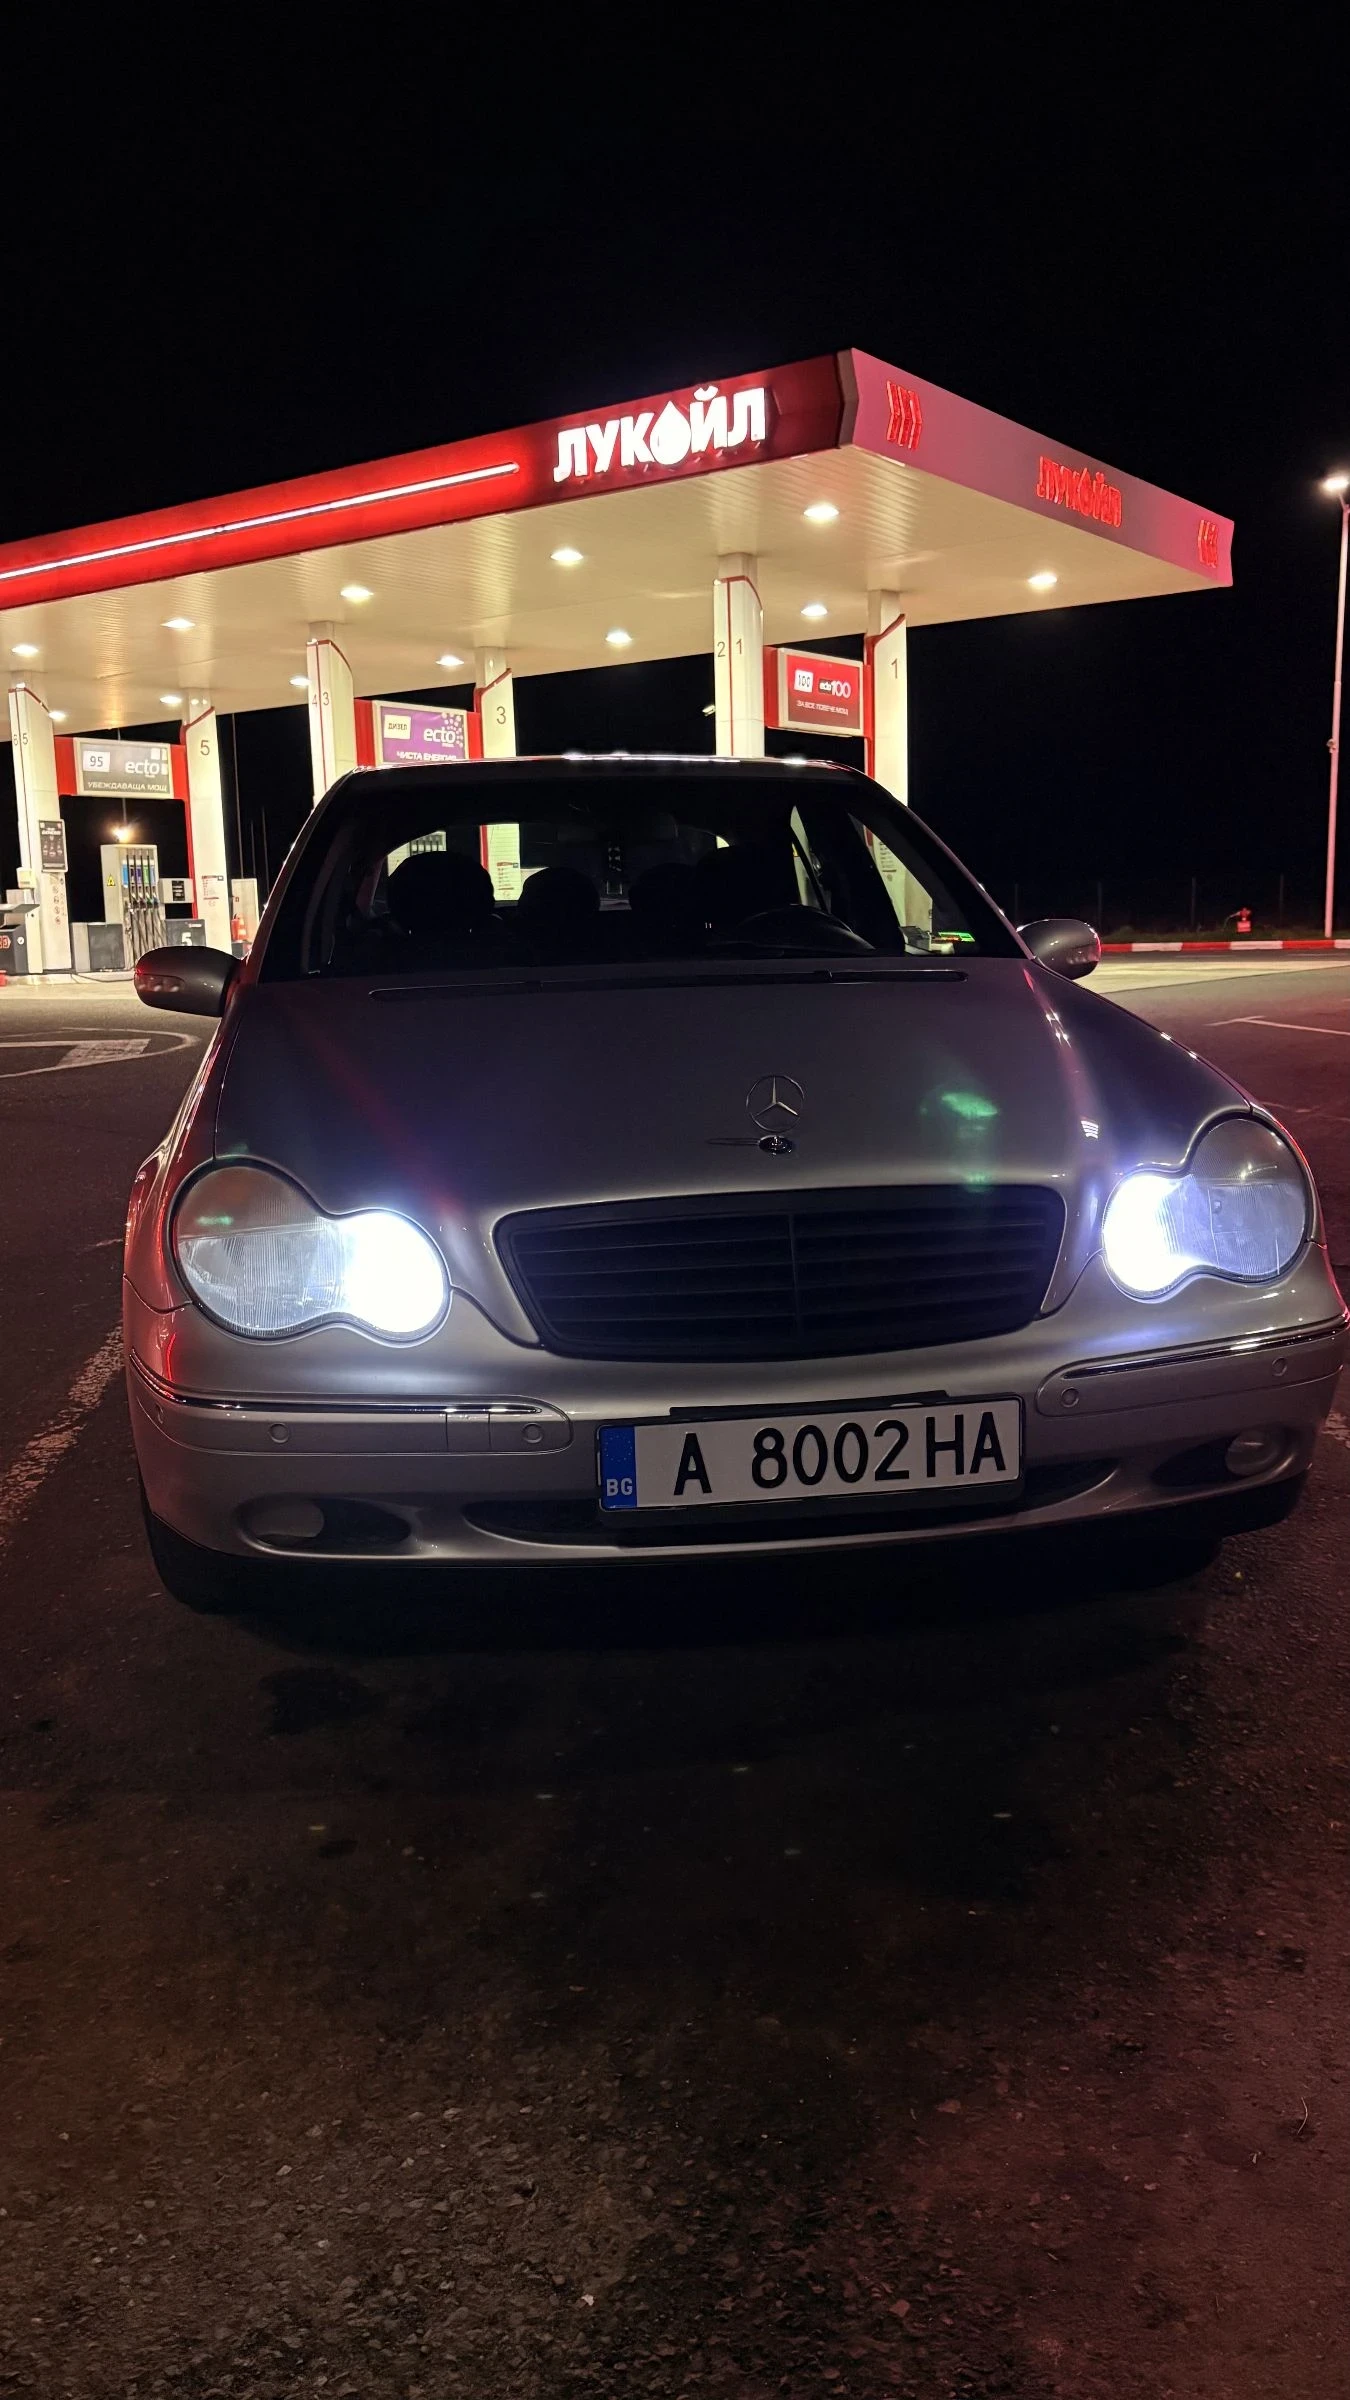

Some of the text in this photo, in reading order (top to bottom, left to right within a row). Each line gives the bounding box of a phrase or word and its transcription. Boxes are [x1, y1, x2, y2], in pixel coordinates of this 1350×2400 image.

[553, 386, 767, 483] ЛУКОЙЛ
[1036, 455, 1123, 528] ЛУКОЙЛ
[716, 641, 726, 658] 2
[735, 638, 743, 655] 1
[890, 658, 899, 680] 1
[798, 674, 811, 688] 100
[311, 694, 318, 707] 4
[322, 691, 330, 706] 3
[496, 706, 507, 725] 3
[388, 722, 408, 730] ДИЗЕЛ
[22, 732, 29, 746] 5
[423, 727, 456, 743] ecto
[199, 740, 211, 756] 5
[396, 751, 423, 761] ЧИСТА
[89, 755, 104, 767] 95
[125, 759, 160, 775] ecto
[87, 781, 168, 792] УБЕЖДАВАЩА МОЩ
[181, 932, 193, 946] 5
[673, 1432, 713, 1496] A
[606, 1477, 634, 1498] BG
